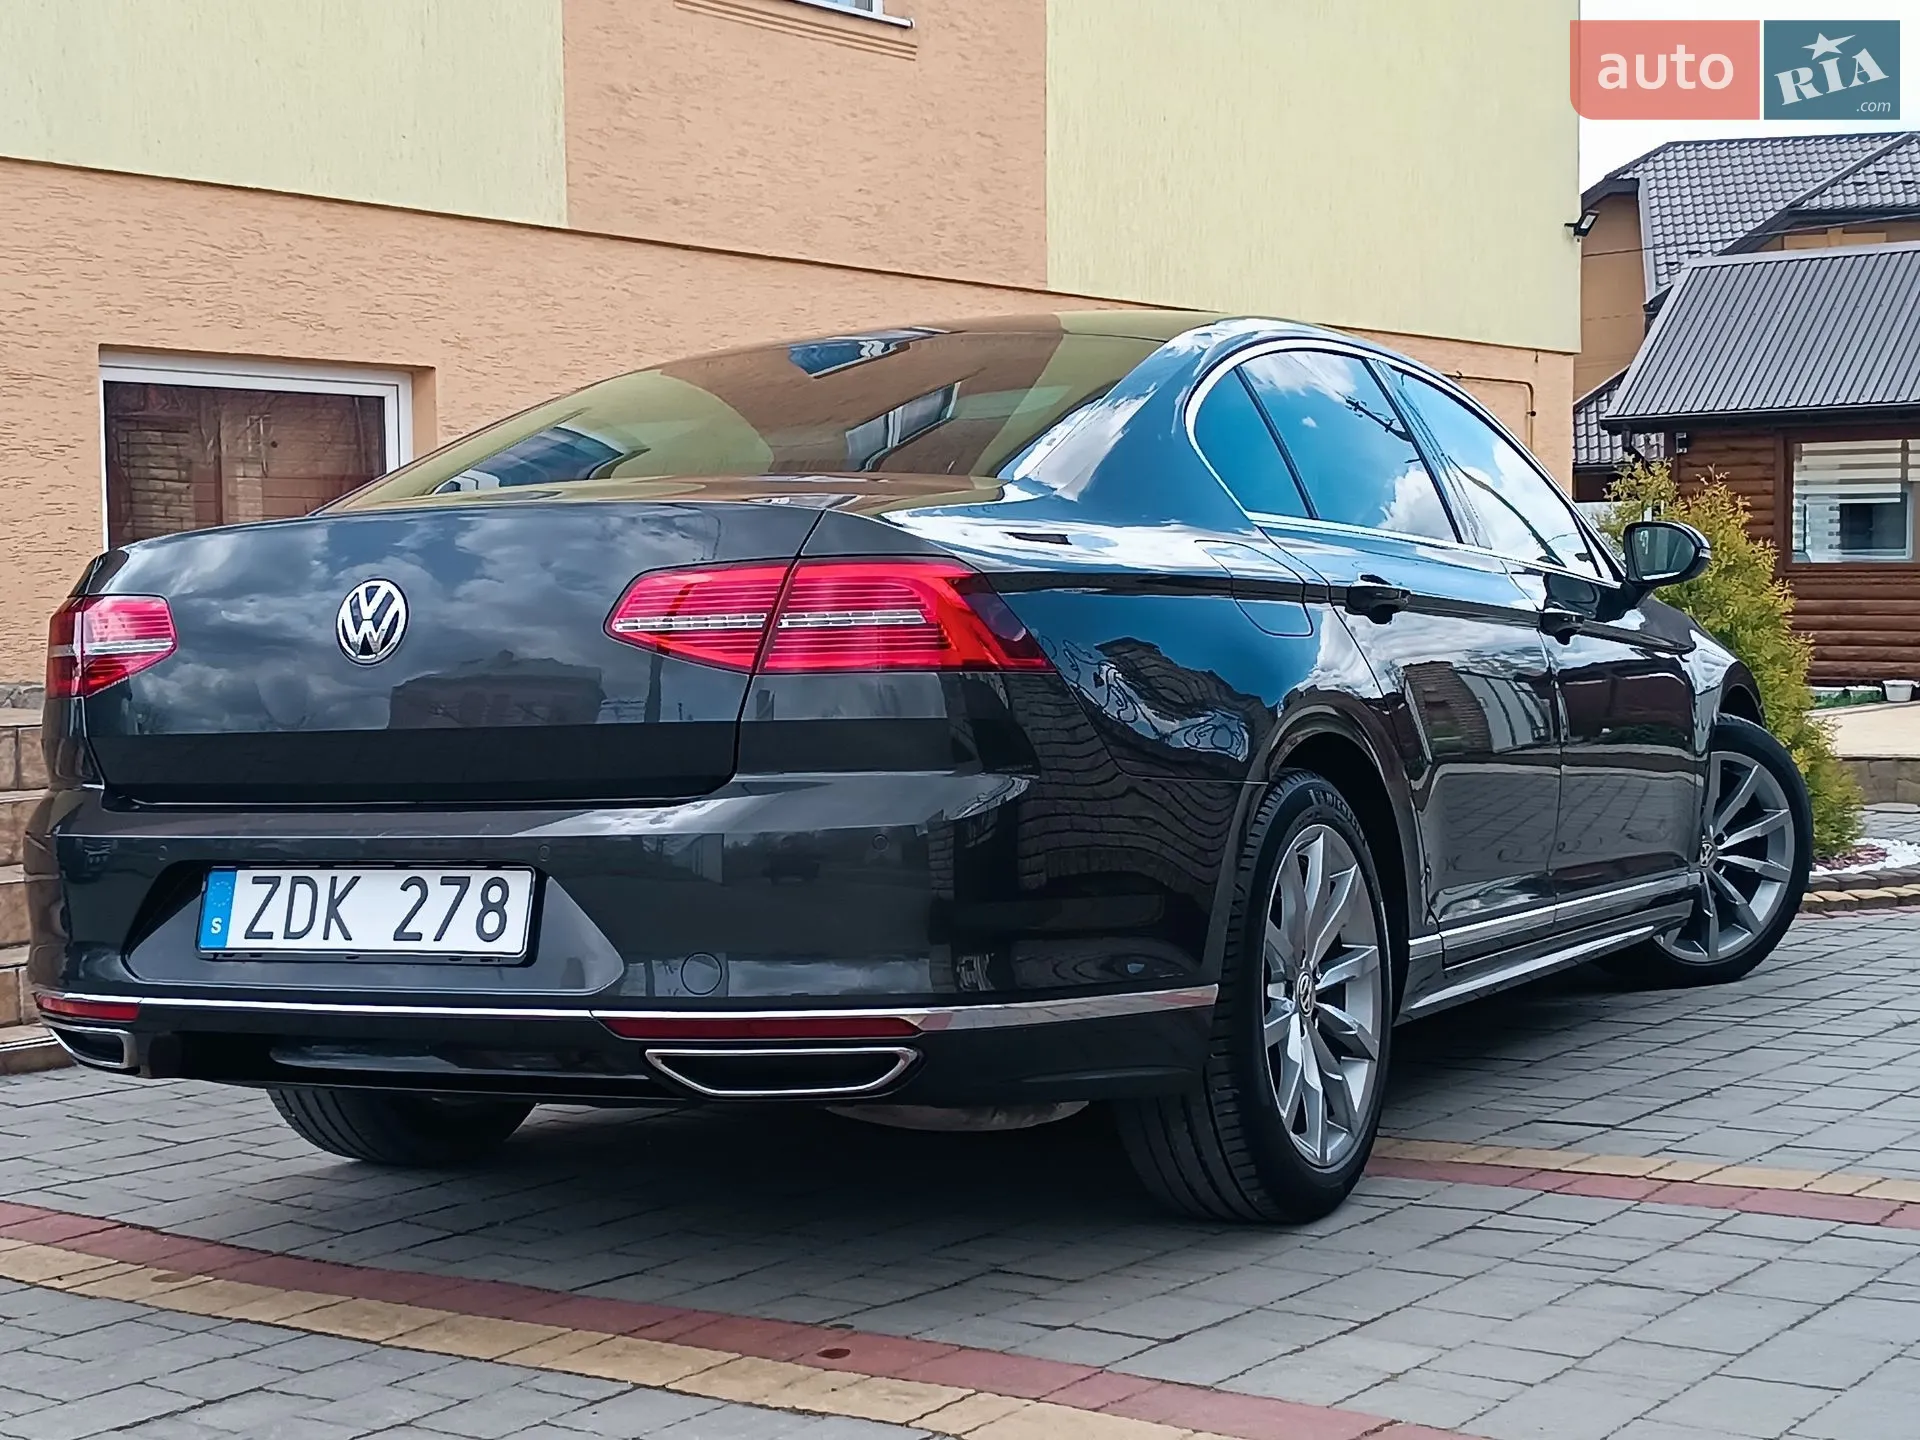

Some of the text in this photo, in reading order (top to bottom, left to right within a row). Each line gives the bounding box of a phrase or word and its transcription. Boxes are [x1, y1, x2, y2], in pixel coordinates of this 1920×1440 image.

[337, 580, 407, 662] VW
[210, 917, 222, 935] S
[244, 875, 510, 943] ZDK 278
